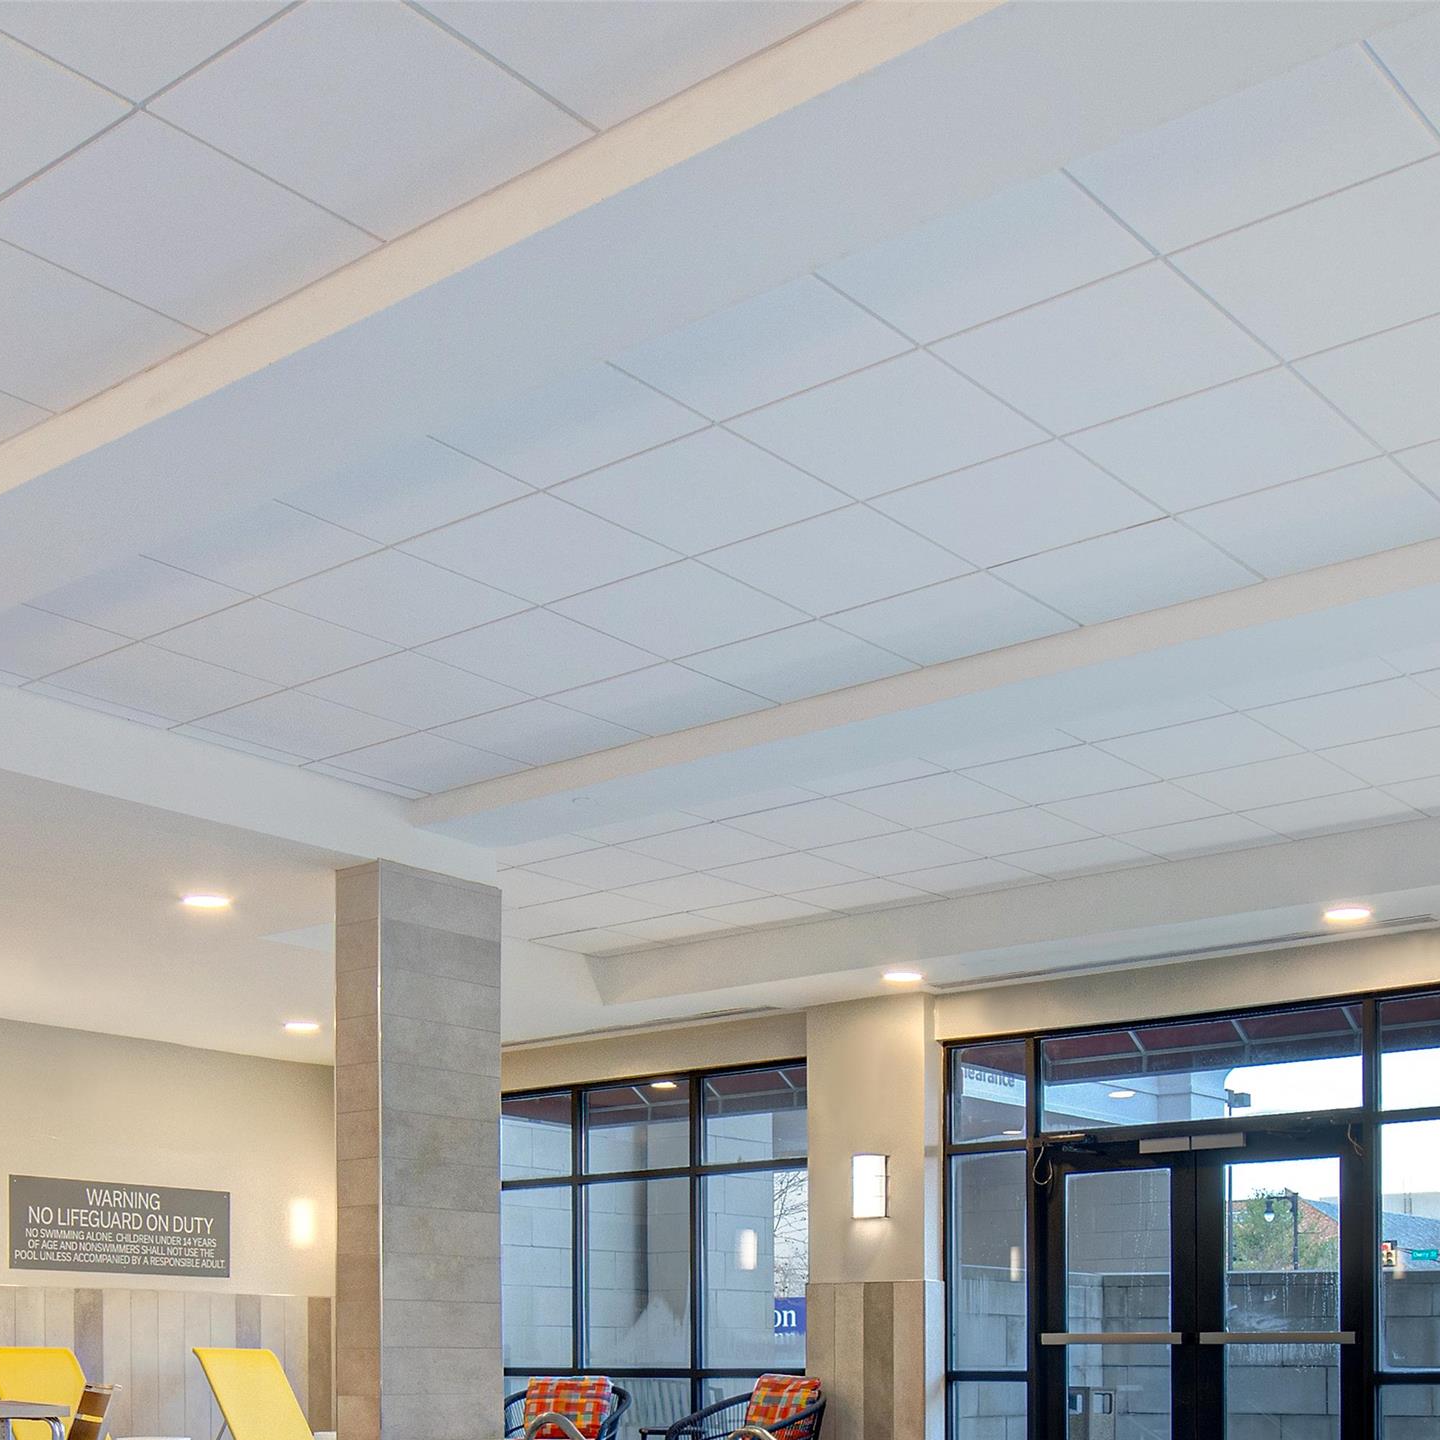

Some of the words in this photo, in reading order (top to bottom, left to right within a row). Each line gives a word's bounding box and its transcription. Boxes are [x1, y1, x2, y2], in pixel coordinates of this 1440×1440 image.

[962, 1068, 1016, 1088] learance
[86, 1188, 161, 1210] WARNING
[28, 1206, 53, 1225] NO
[57, 1207, 143, 1231] LIFEGUARD
[147, 1214, 169, 1232] ON
[173, 1215, 214, 1234] DUTY
[25, 1228, 39, 1238] NO
[40, 1228, 85, 1240] SWIMMING
[116, 1233, 154, 1244] CHILDREN
[155, 1235, 182, 1245] UNDER
[183, 1237, 192, 1246] 14
[192, 1237, 217, 1248] YEARS
[27, 1239, 40, 1249] OF
[41, 1240, 58, 1250] AGE
[59, 1241, 78, 1251] AND
[79, 1242, 140, 1254] NONSWIMMERS
[141, 1245, 165, 1256] SHALL
[167, 1246, 183, 1256] NOT
[184, 1247, 199, 1257] USE
[200, 1248, 215, 1258] THE
[14, 1250, 38, 1260] POOL
[39, 1250, 72, 1262] UNLESS
[72, 1252, 130, 1264] ACCOMPANIED
[131, 1256, 142, 1265] BY
[142, 1256, 149, 1265] A
[150, 1257, 200, 1268] RESPONSIBLE
